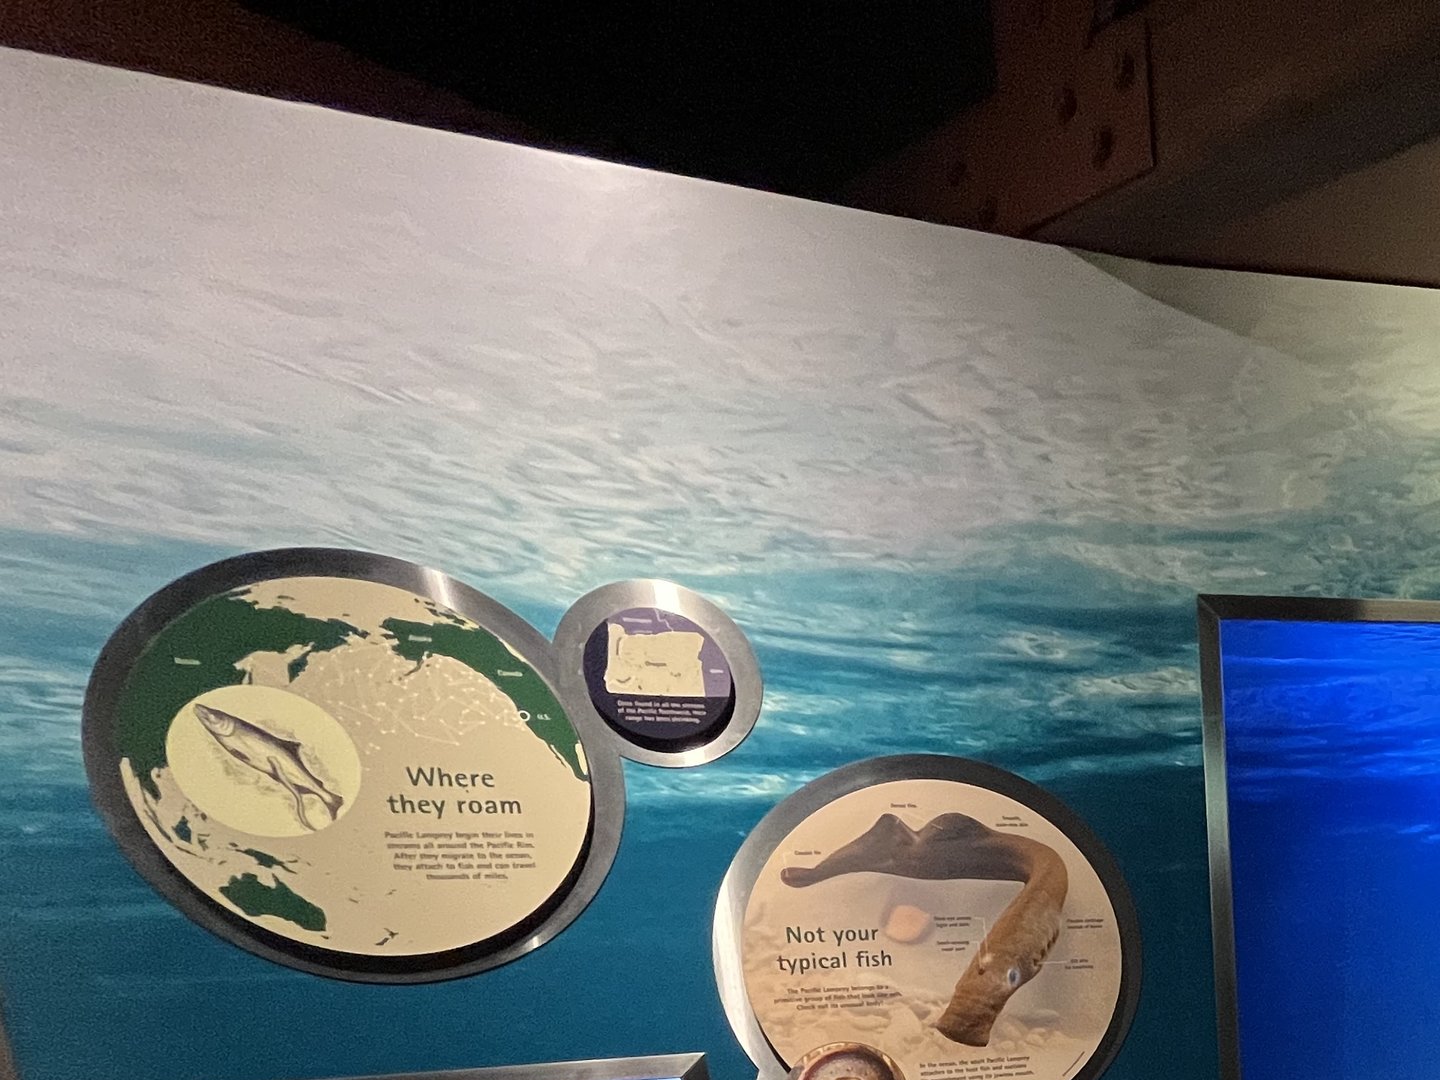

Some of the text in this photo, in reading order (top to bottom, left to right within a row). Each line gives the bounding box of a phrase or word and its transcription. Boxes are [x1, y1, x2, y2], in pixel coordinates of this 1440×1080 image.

[406, 766, 496, 788] Where
[386, 794, 523, 819] they roam
[785, 926, 879, 947] Not your
[777, 950, 893, 976] typical fish
